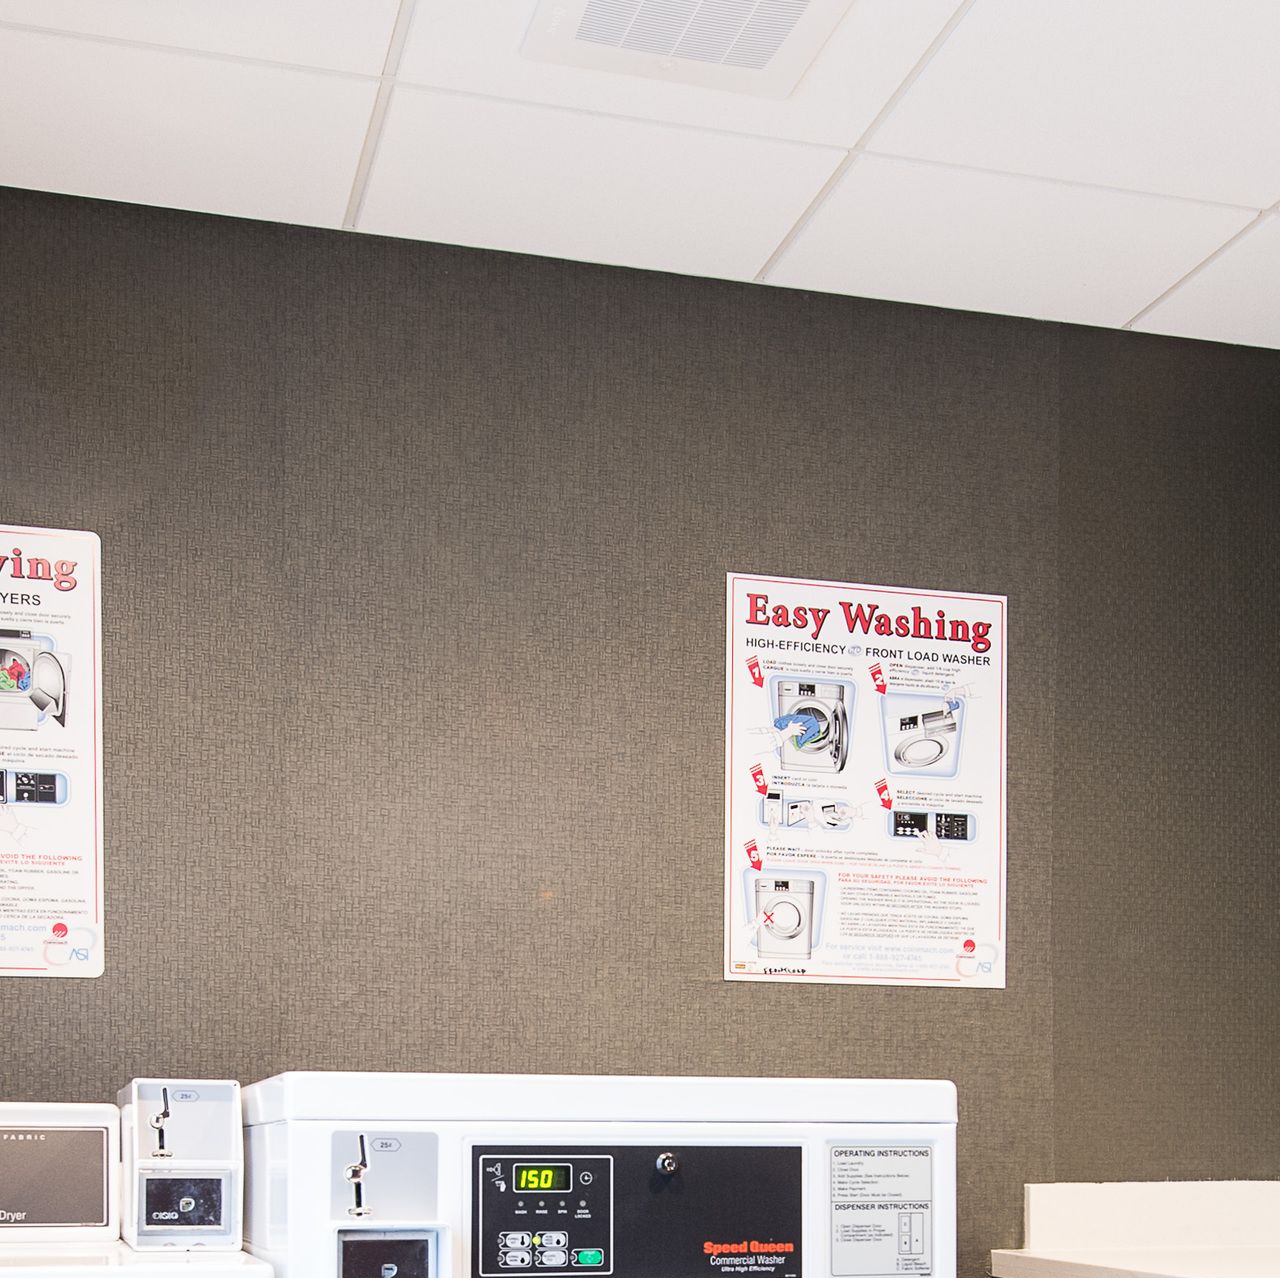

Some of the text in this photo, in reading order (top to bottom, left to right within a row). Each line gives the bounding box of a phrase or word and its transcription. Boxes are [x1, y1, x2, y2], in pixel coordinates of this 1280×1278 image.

[746, 593, 992, 654] Easy Washing
[746, 638, 847, 655] HIGH-EFFICIENCY
[865, 648, 904, 660] FRONT
[907, 651, 939, 662] LOAD
[942, 654, 991, 666] WASHER
[752, 667, 759, 678] 1
[875, 674, 884, 685] 2
[756, 774, 764, 786] 3
[750, 850, 759, 862] 5
[825, 942, 838, 951] For
[520, 1170, 553, 1189] 150
[835, 1203, 876, 1211] DISPENSER
[703, 1241, 794, 1256] Speed Queen
[710, 1255, 786, 1265] Commercial Washer
